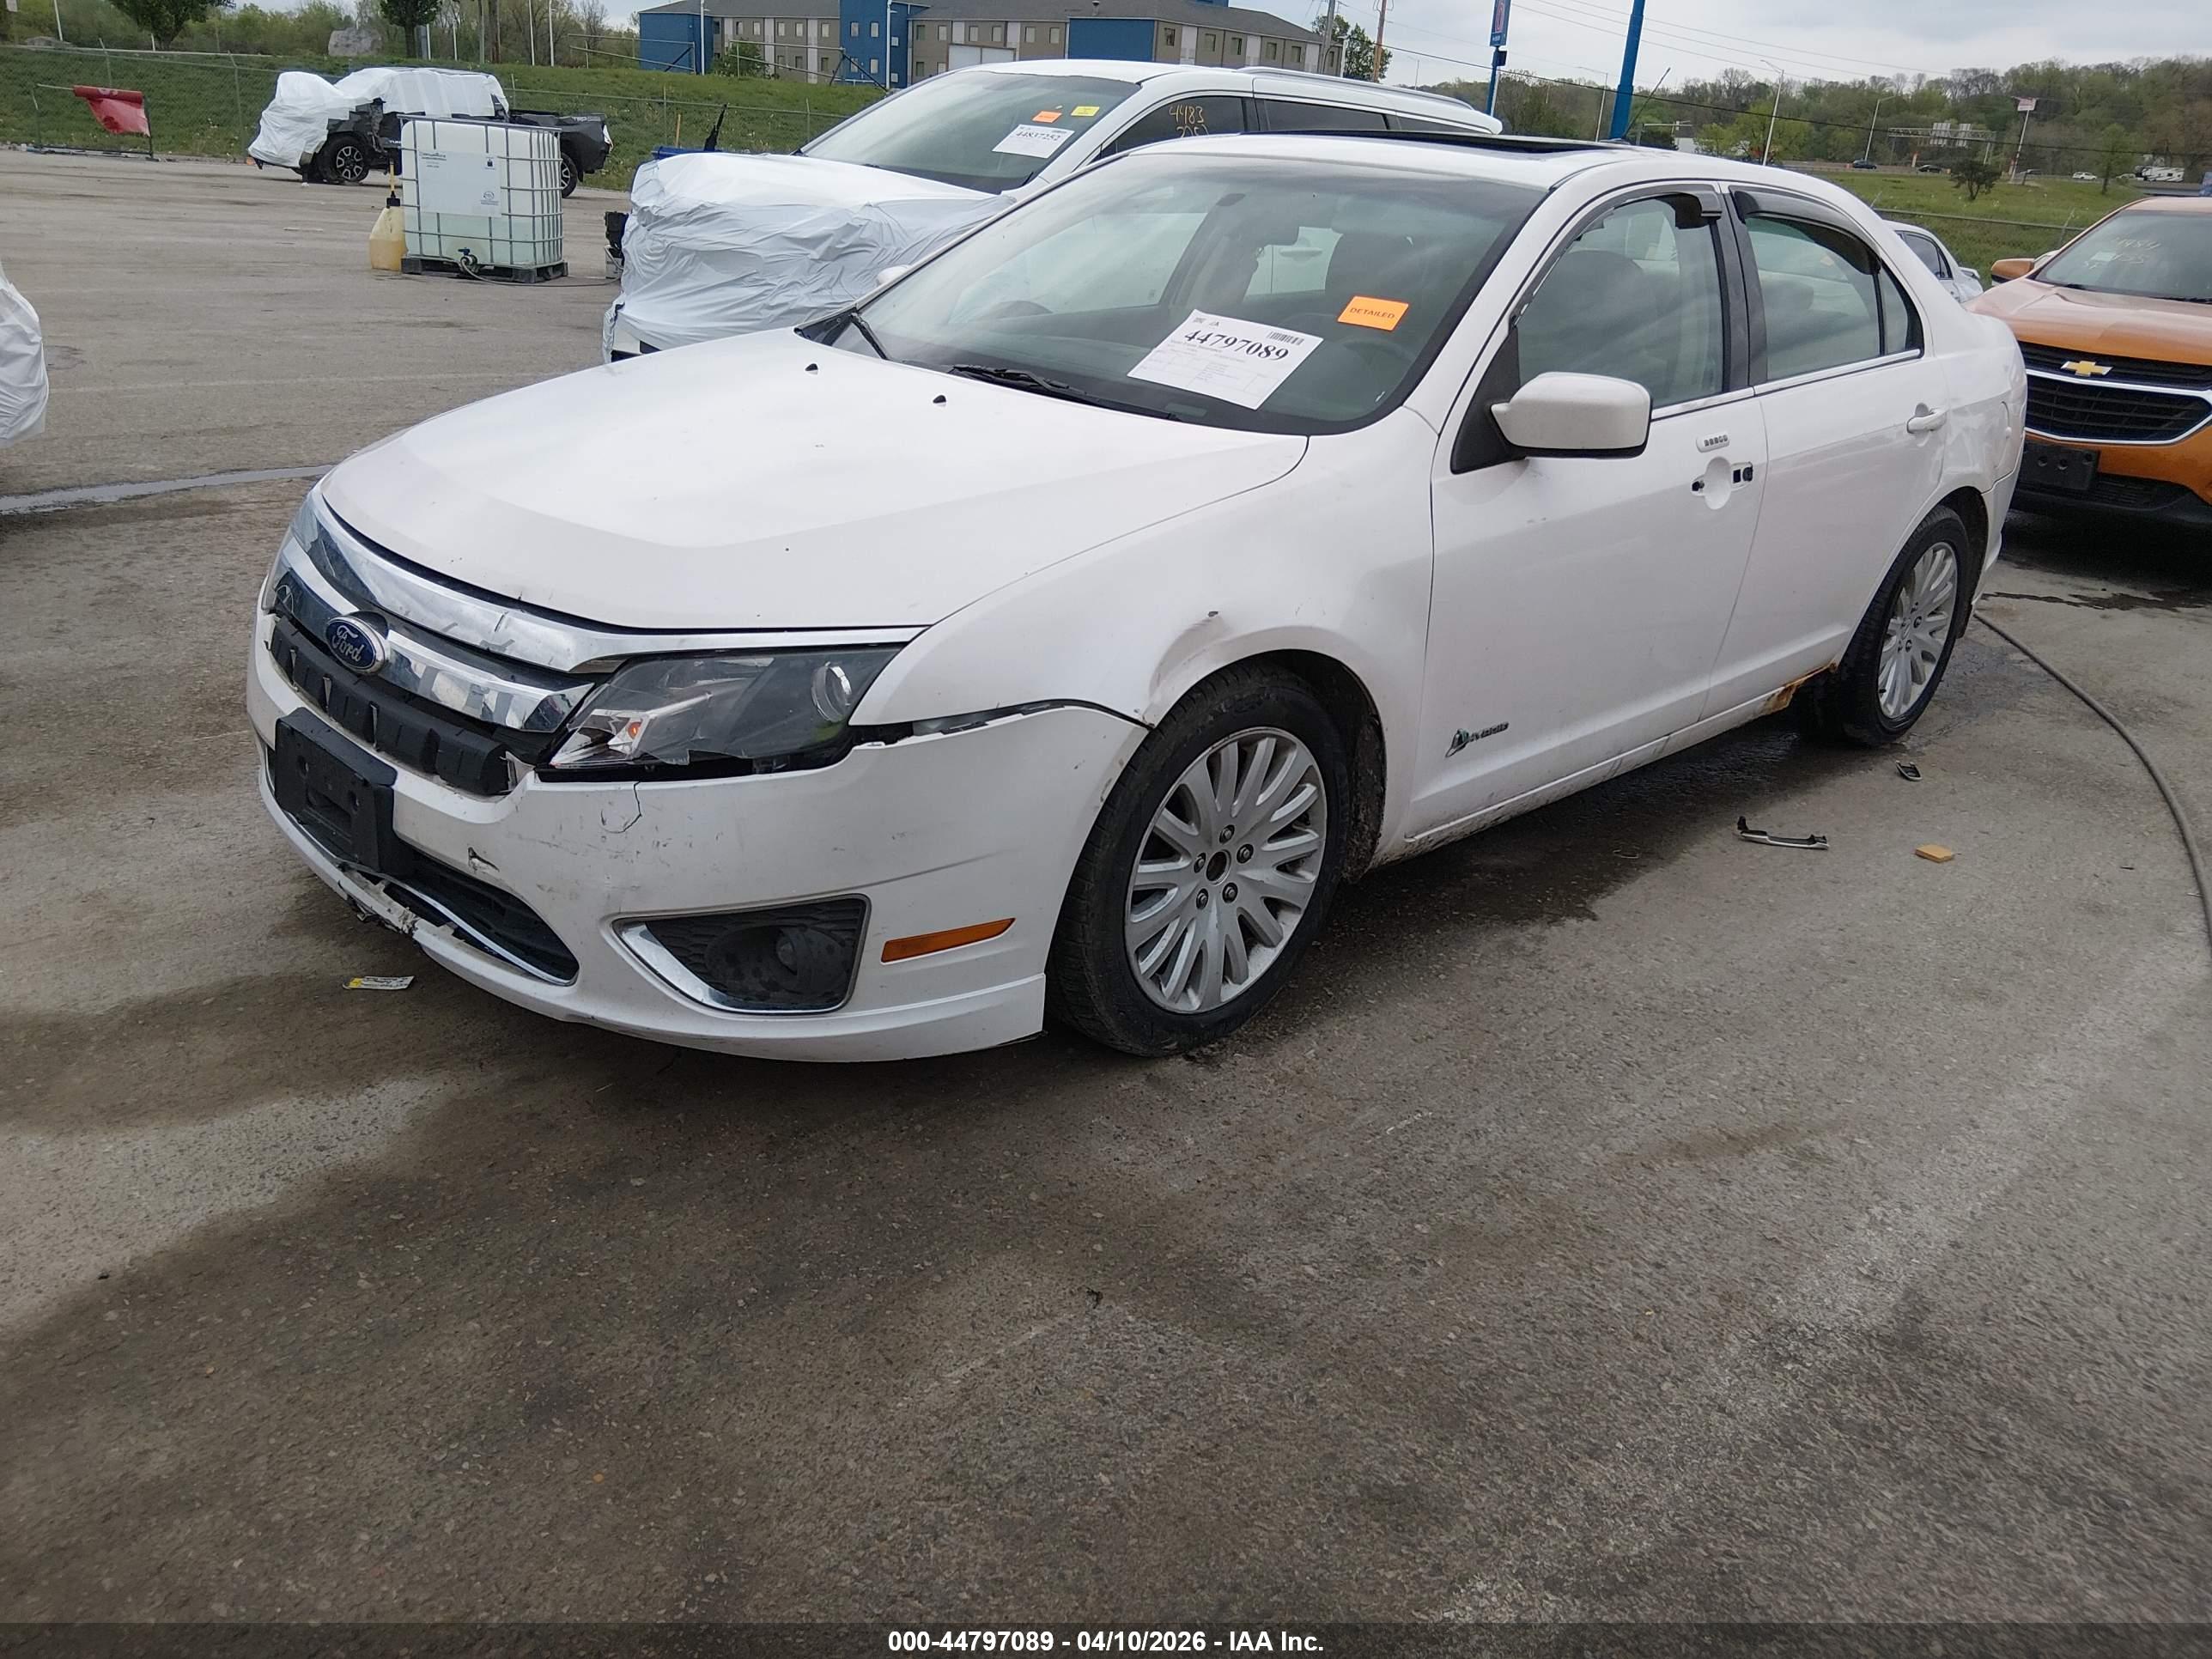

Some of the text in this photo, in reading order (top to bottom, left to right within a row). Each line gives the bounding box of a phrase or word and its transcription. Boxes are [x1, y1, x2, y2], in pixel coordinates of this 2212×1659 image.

[1349, 307, 1395, 319] DETAILED
[1184, 330, 1289, 361] 44797089
[331, 625, 364, 661] Ford
